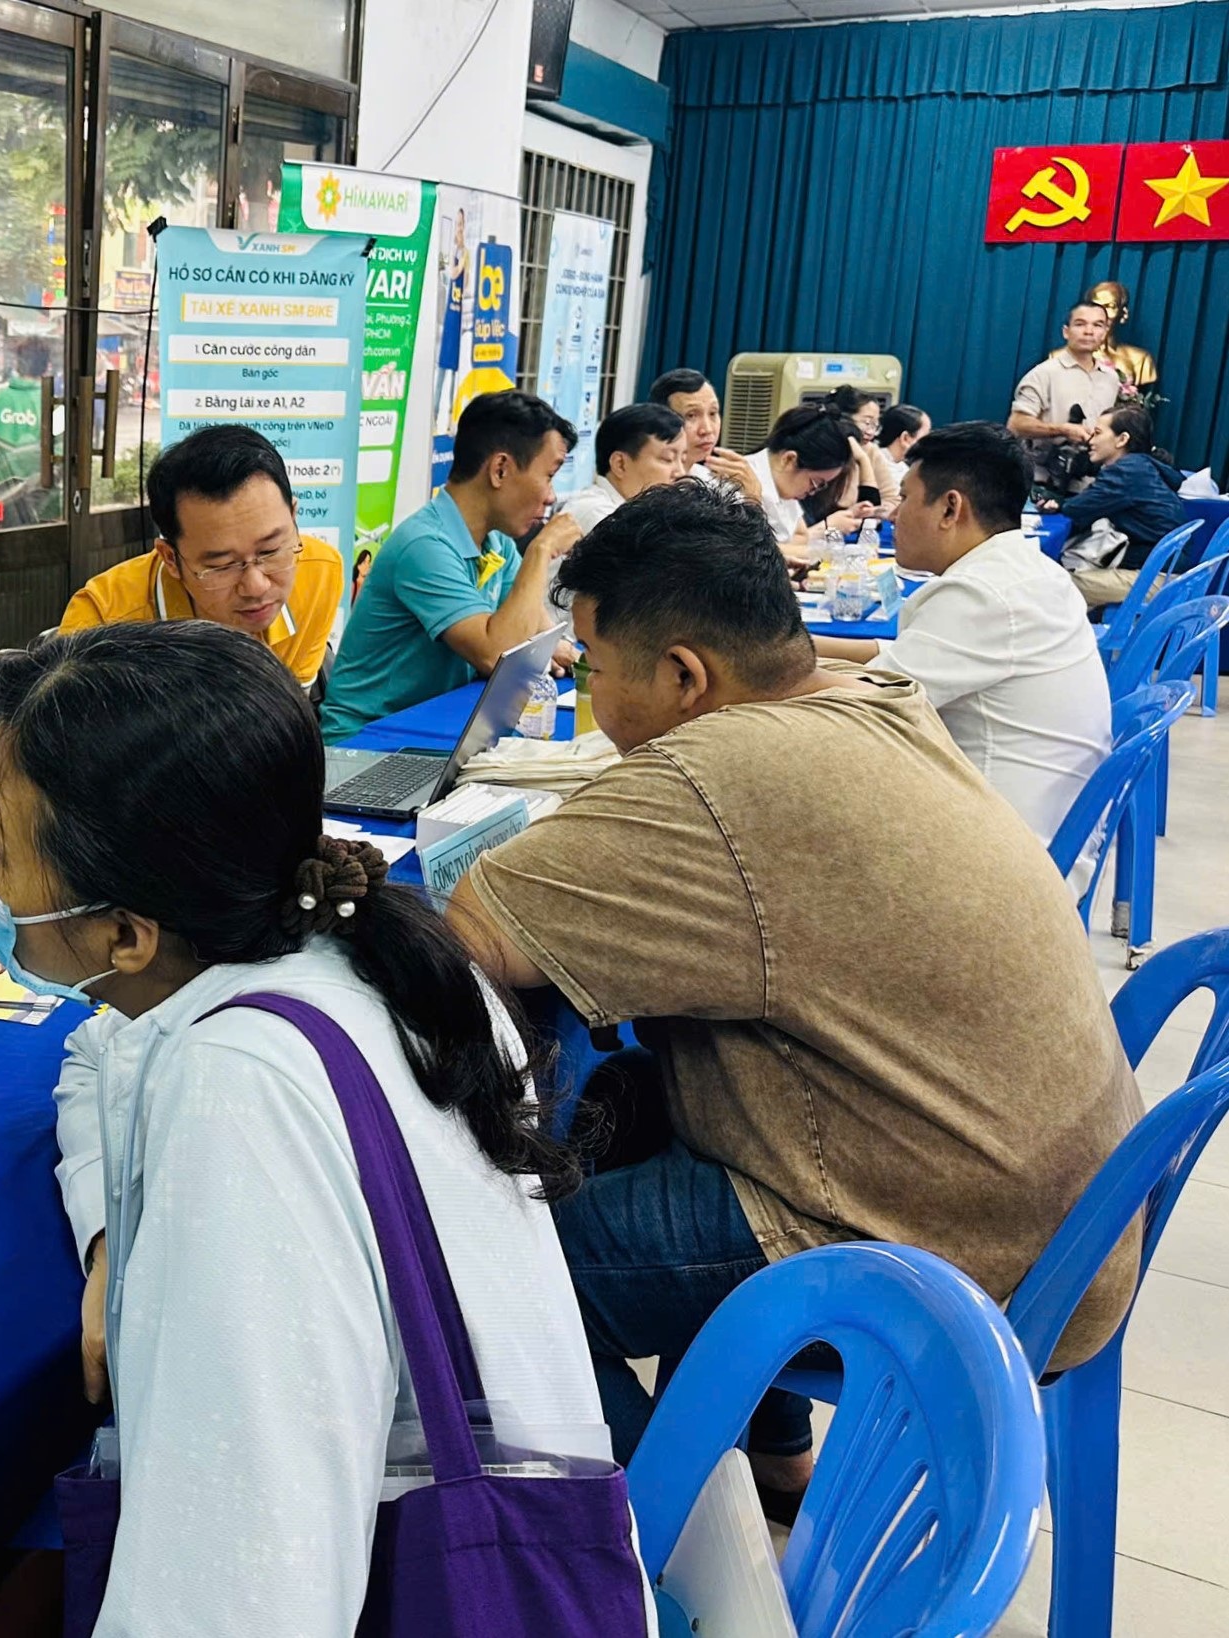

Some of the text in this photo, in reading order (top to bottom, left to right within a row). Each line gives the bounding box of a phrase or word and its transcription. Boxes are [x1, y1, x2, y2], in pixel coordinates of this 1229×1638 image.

[252, 243, 296, 254] XANH SM
[378, 248, 402, 263] DỊCH
[192, 267, 212, 281] SƠ
[249, 266, 270, 284] CÓ
[273, 271, 295, 284] KHI
[299, 270, 338, 286] ĐĂNG
[365, 268, 413, 300] ARI
[478, 248, 505, 311] be
[239, 302, 281, 317] XANH
[283, 303, 305, 317] SM
[307, 304, 334, 318] BIKE
[257, 399, 270, 408] xe
[290, 397, 305, 408] A2
[0, 408, 37, 427] Grab
[293, 465, 321, 478] hoặc
[323, 464, 330, 476] 2
